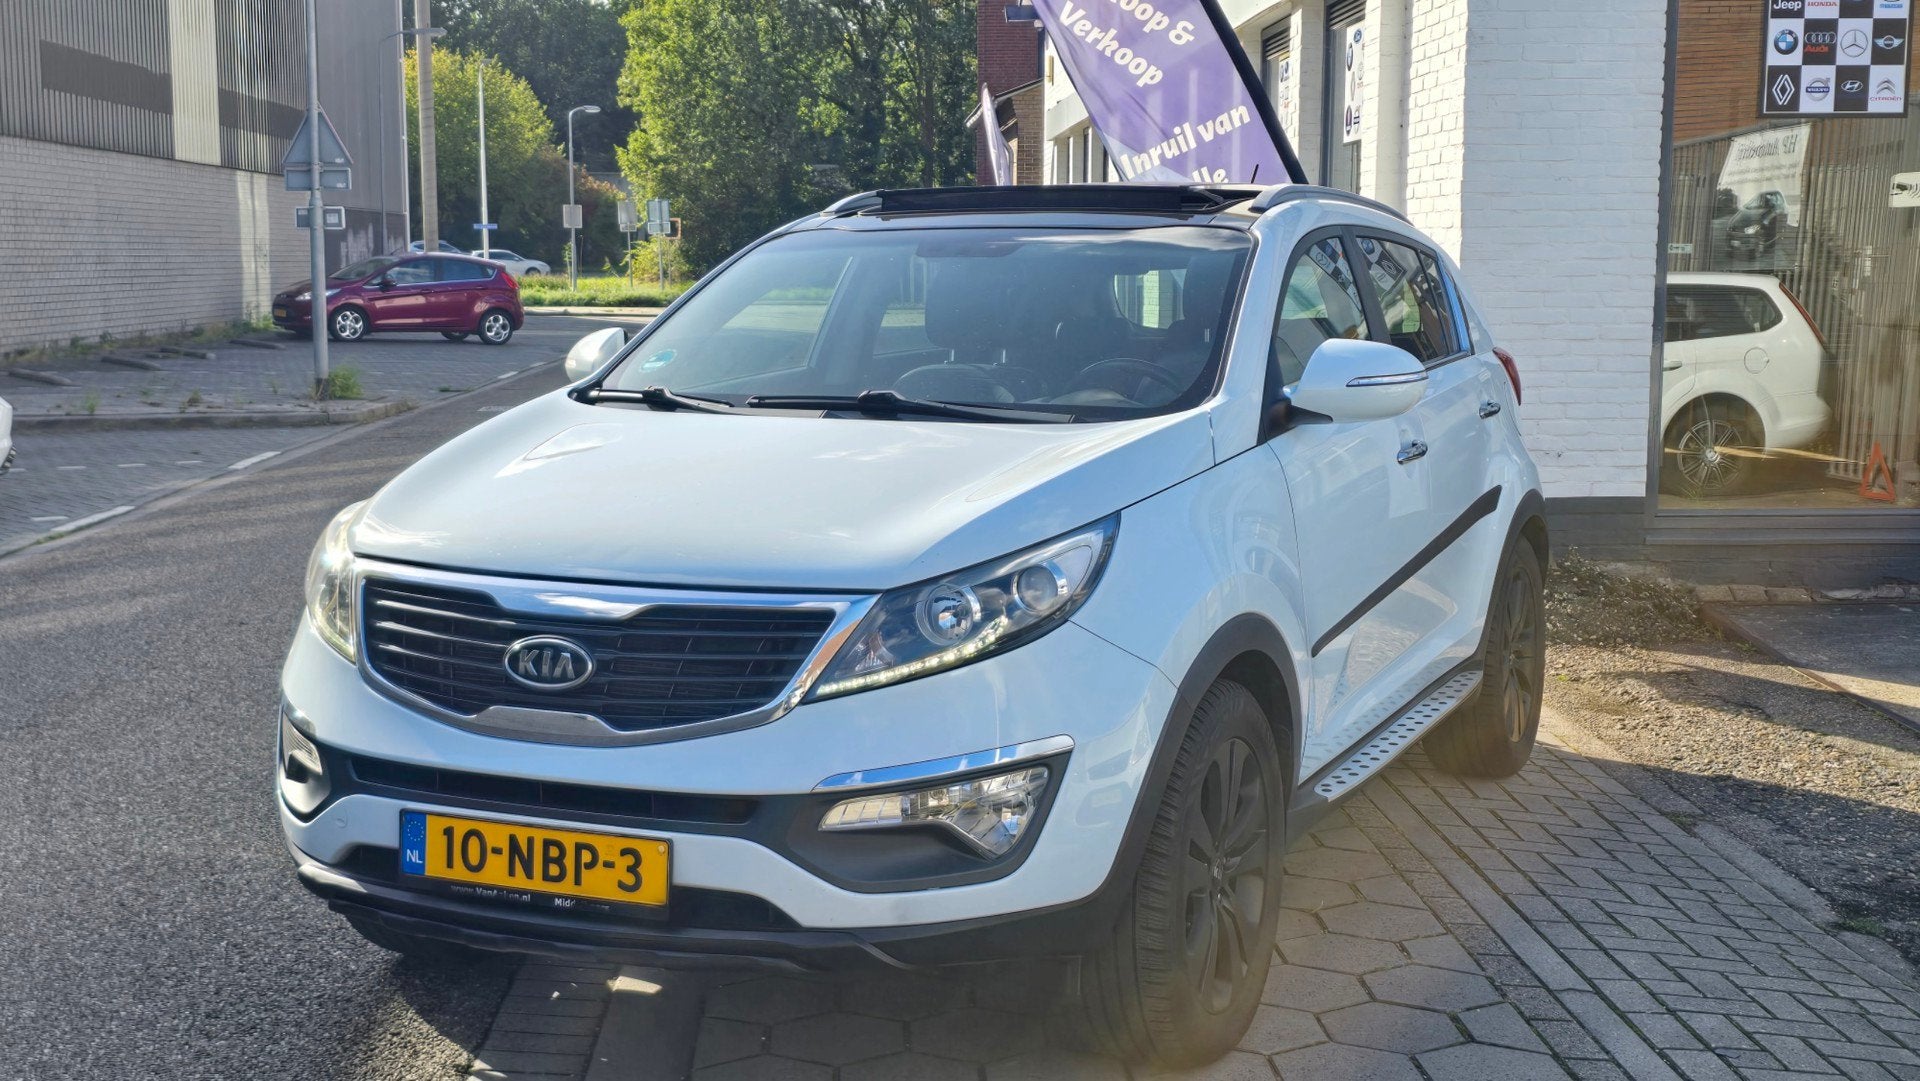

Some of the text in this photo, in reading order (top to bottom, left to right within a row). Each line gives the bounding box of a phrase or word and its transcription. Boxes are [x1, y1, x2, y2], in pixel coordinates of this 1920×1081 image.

[1773, 0, 1801, 11] Jeep
[1107, 0, 1196, 46] oop &
[1059, 1, 1163, 87] Verkoop
[1804, 44, 1829, 53] Audi
[1119, 105, 1250, 180] Inruil van
[1191, 166, 1229, 183] lle
[518, 649, 576, 680] KIA
[406, 849, 423, 864] NL
[443, 825, 643, 893] 10-NBP-3
